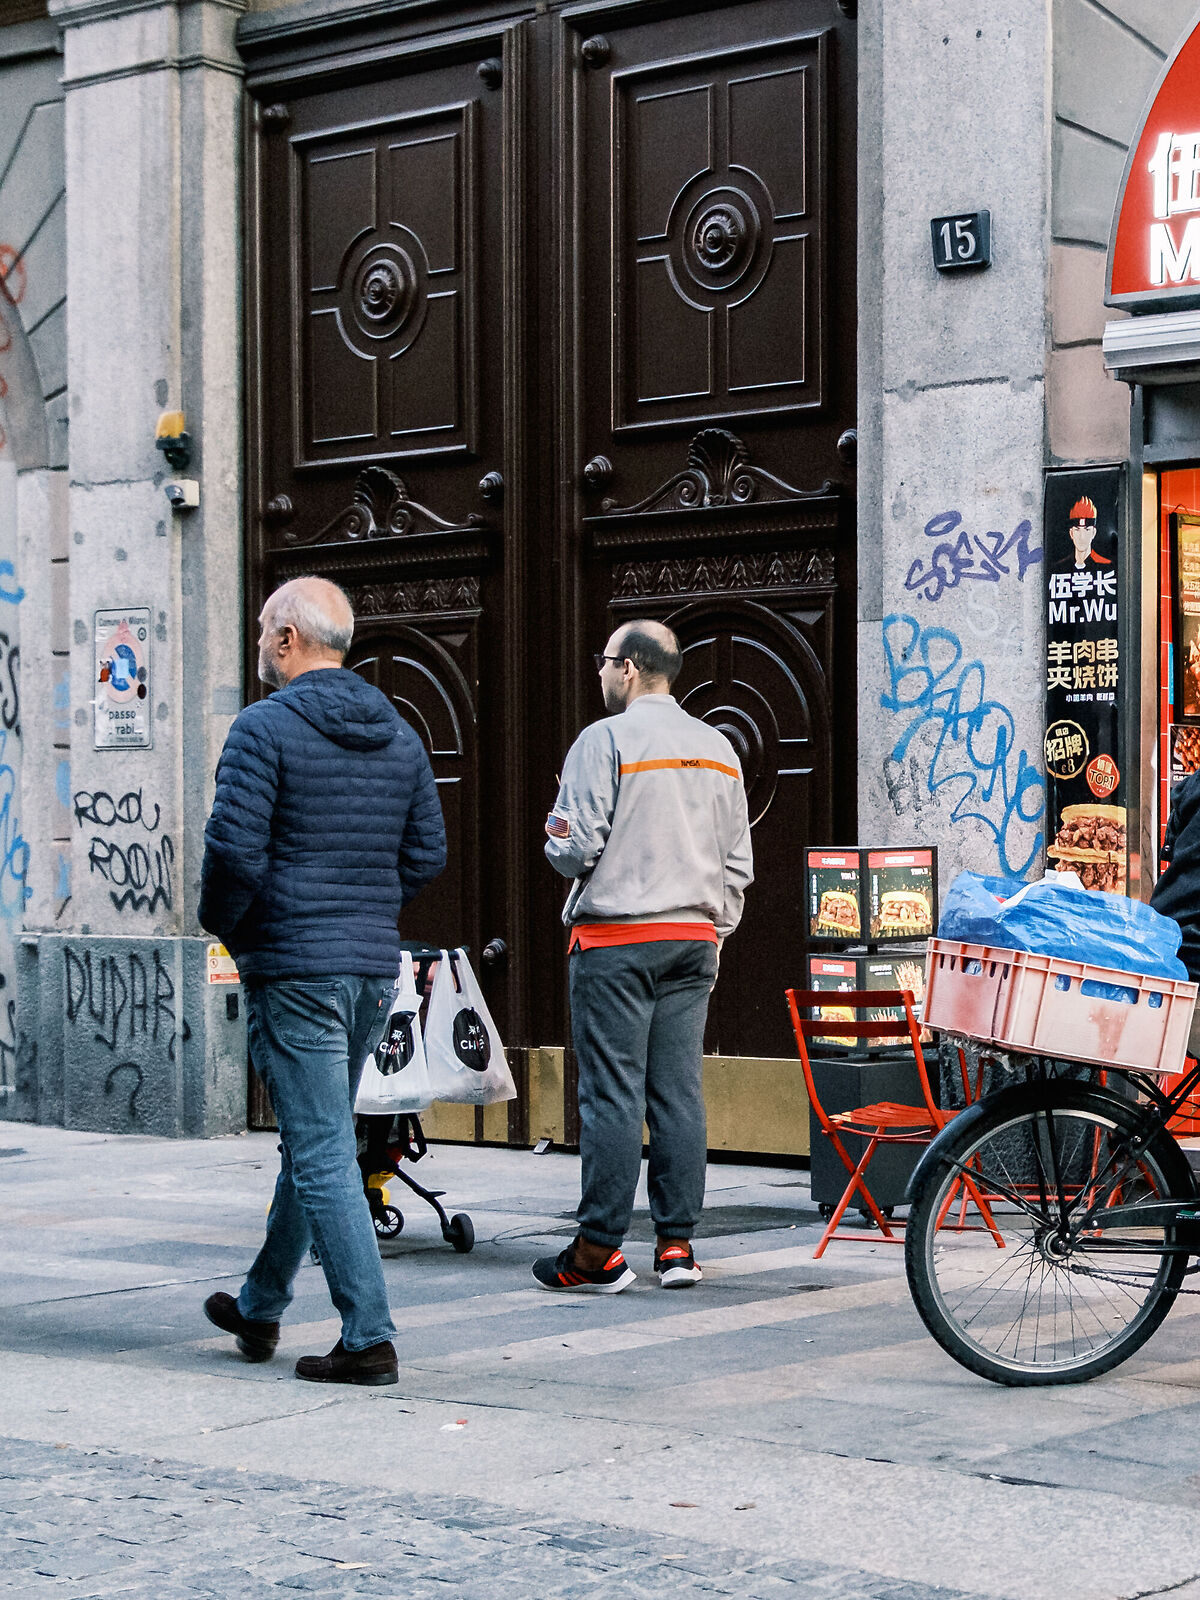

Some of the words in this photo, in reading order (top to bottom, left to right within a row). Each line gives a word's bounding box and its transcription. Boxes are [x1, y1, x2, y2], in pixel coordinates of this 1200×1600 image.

[937, 218, 978, 263] 15
[1048, 570, 1117, 599] 伍学长
[1048, 598, 1117, 625] Mr.Wu
[1047, 638, 1119, 665] 羊肉串
[1047, 663, 1119, 691] 夹烧饼
[1047, 734, 1084, 763] 招牌
